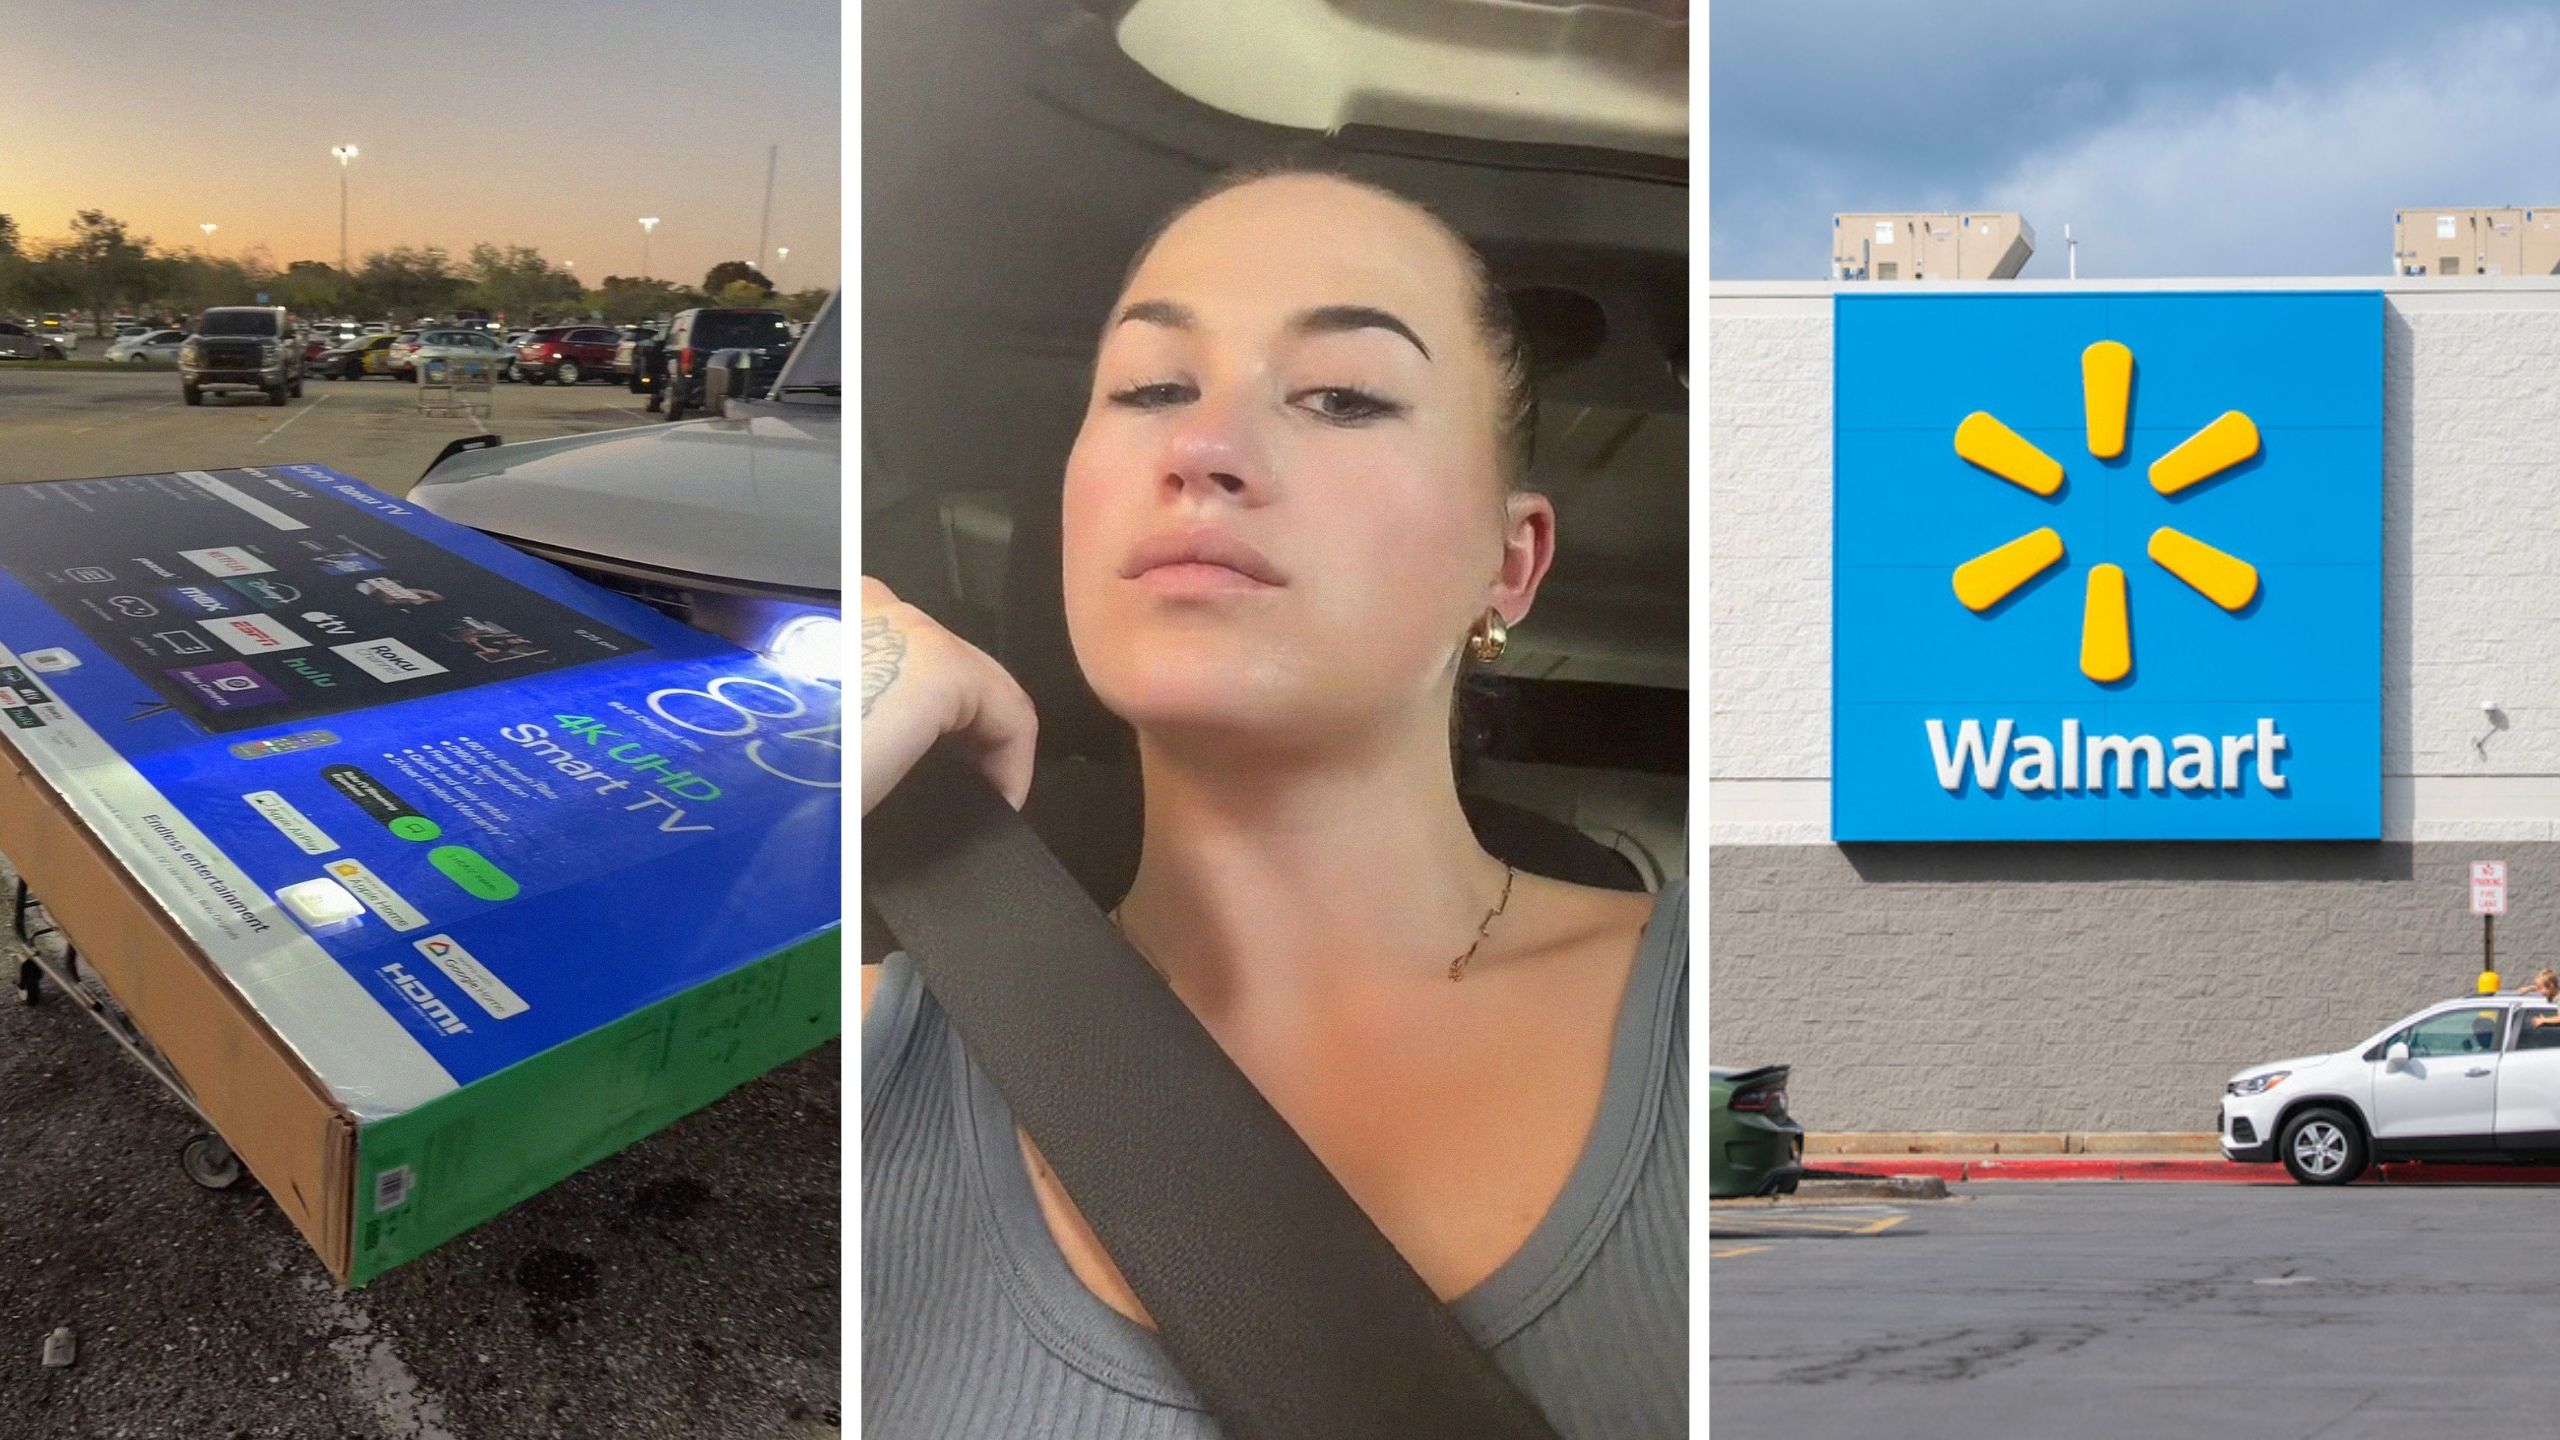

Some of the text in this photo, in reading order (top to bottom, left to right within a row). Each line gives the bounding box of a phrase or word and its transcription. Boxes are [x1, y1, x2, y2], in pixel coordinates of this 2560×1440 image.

[290, 466, 334, 482] onn
[376, 504, 412, 514] TV
[178, 588, 228, 611] max
[230, 622, 280, 646] ESPN
[317, 621, 354, 634] tv
[282, 658, 336, 686] hulu
[554, 715, 721, 800] 4K UHD
[1925, 718, 2287, 791] Walmart
[416, 778, 458, 802] Limited
[435, 773, 460, 785] and
[467, 775, 488, 785] TV
[500, 724, 715, 832] Smart TV
[266, 807, 321, 851] Apple AirPlay
[142, 815, 185, 851] Endless
[182, 853, 270, 933] entertainment
[344, 879, 408, 926] Apple Home
[444, 960, 478, 988] Google
[381, 962, 469, 1035] HDMI
